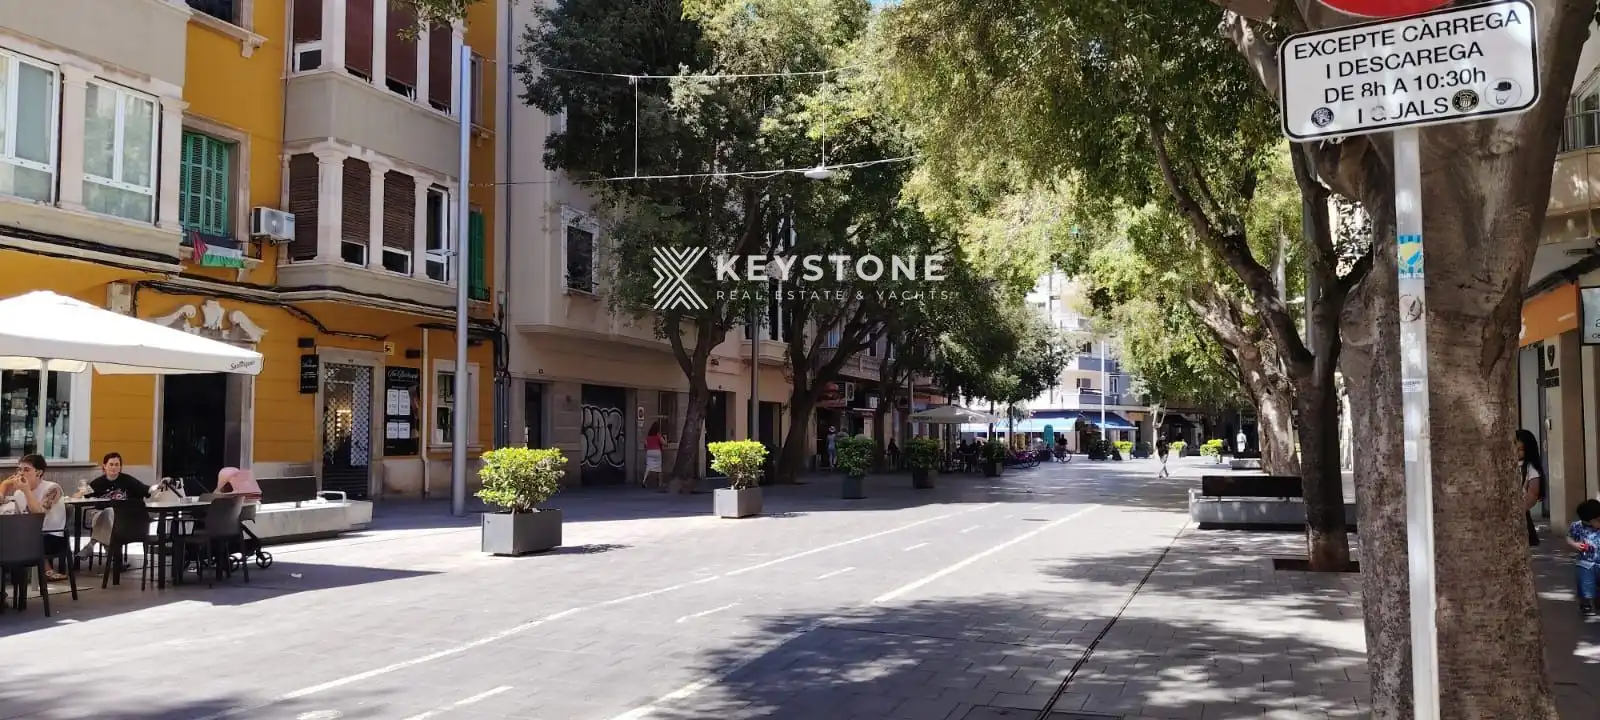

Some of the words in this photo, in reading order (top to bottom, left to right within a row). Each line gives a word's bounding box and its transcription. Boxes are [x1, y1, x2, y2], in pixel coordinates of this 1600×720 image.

[1295, 30, 1395, 59] EXCEPTE
[1402, 10, 1521, 42] CÀRREGA
[1326, 64, 1331, 79] I
[1339, 42, 1484, 77] DESCAREGA
[1325, 85, 1354, 104] DE
[1361, 82, 1386, 97] 8h
[1393, 78, 1408, 95] A
[1415, 67, 1486, 91] 10:30h
[1358, 109, 1363, 123] I
